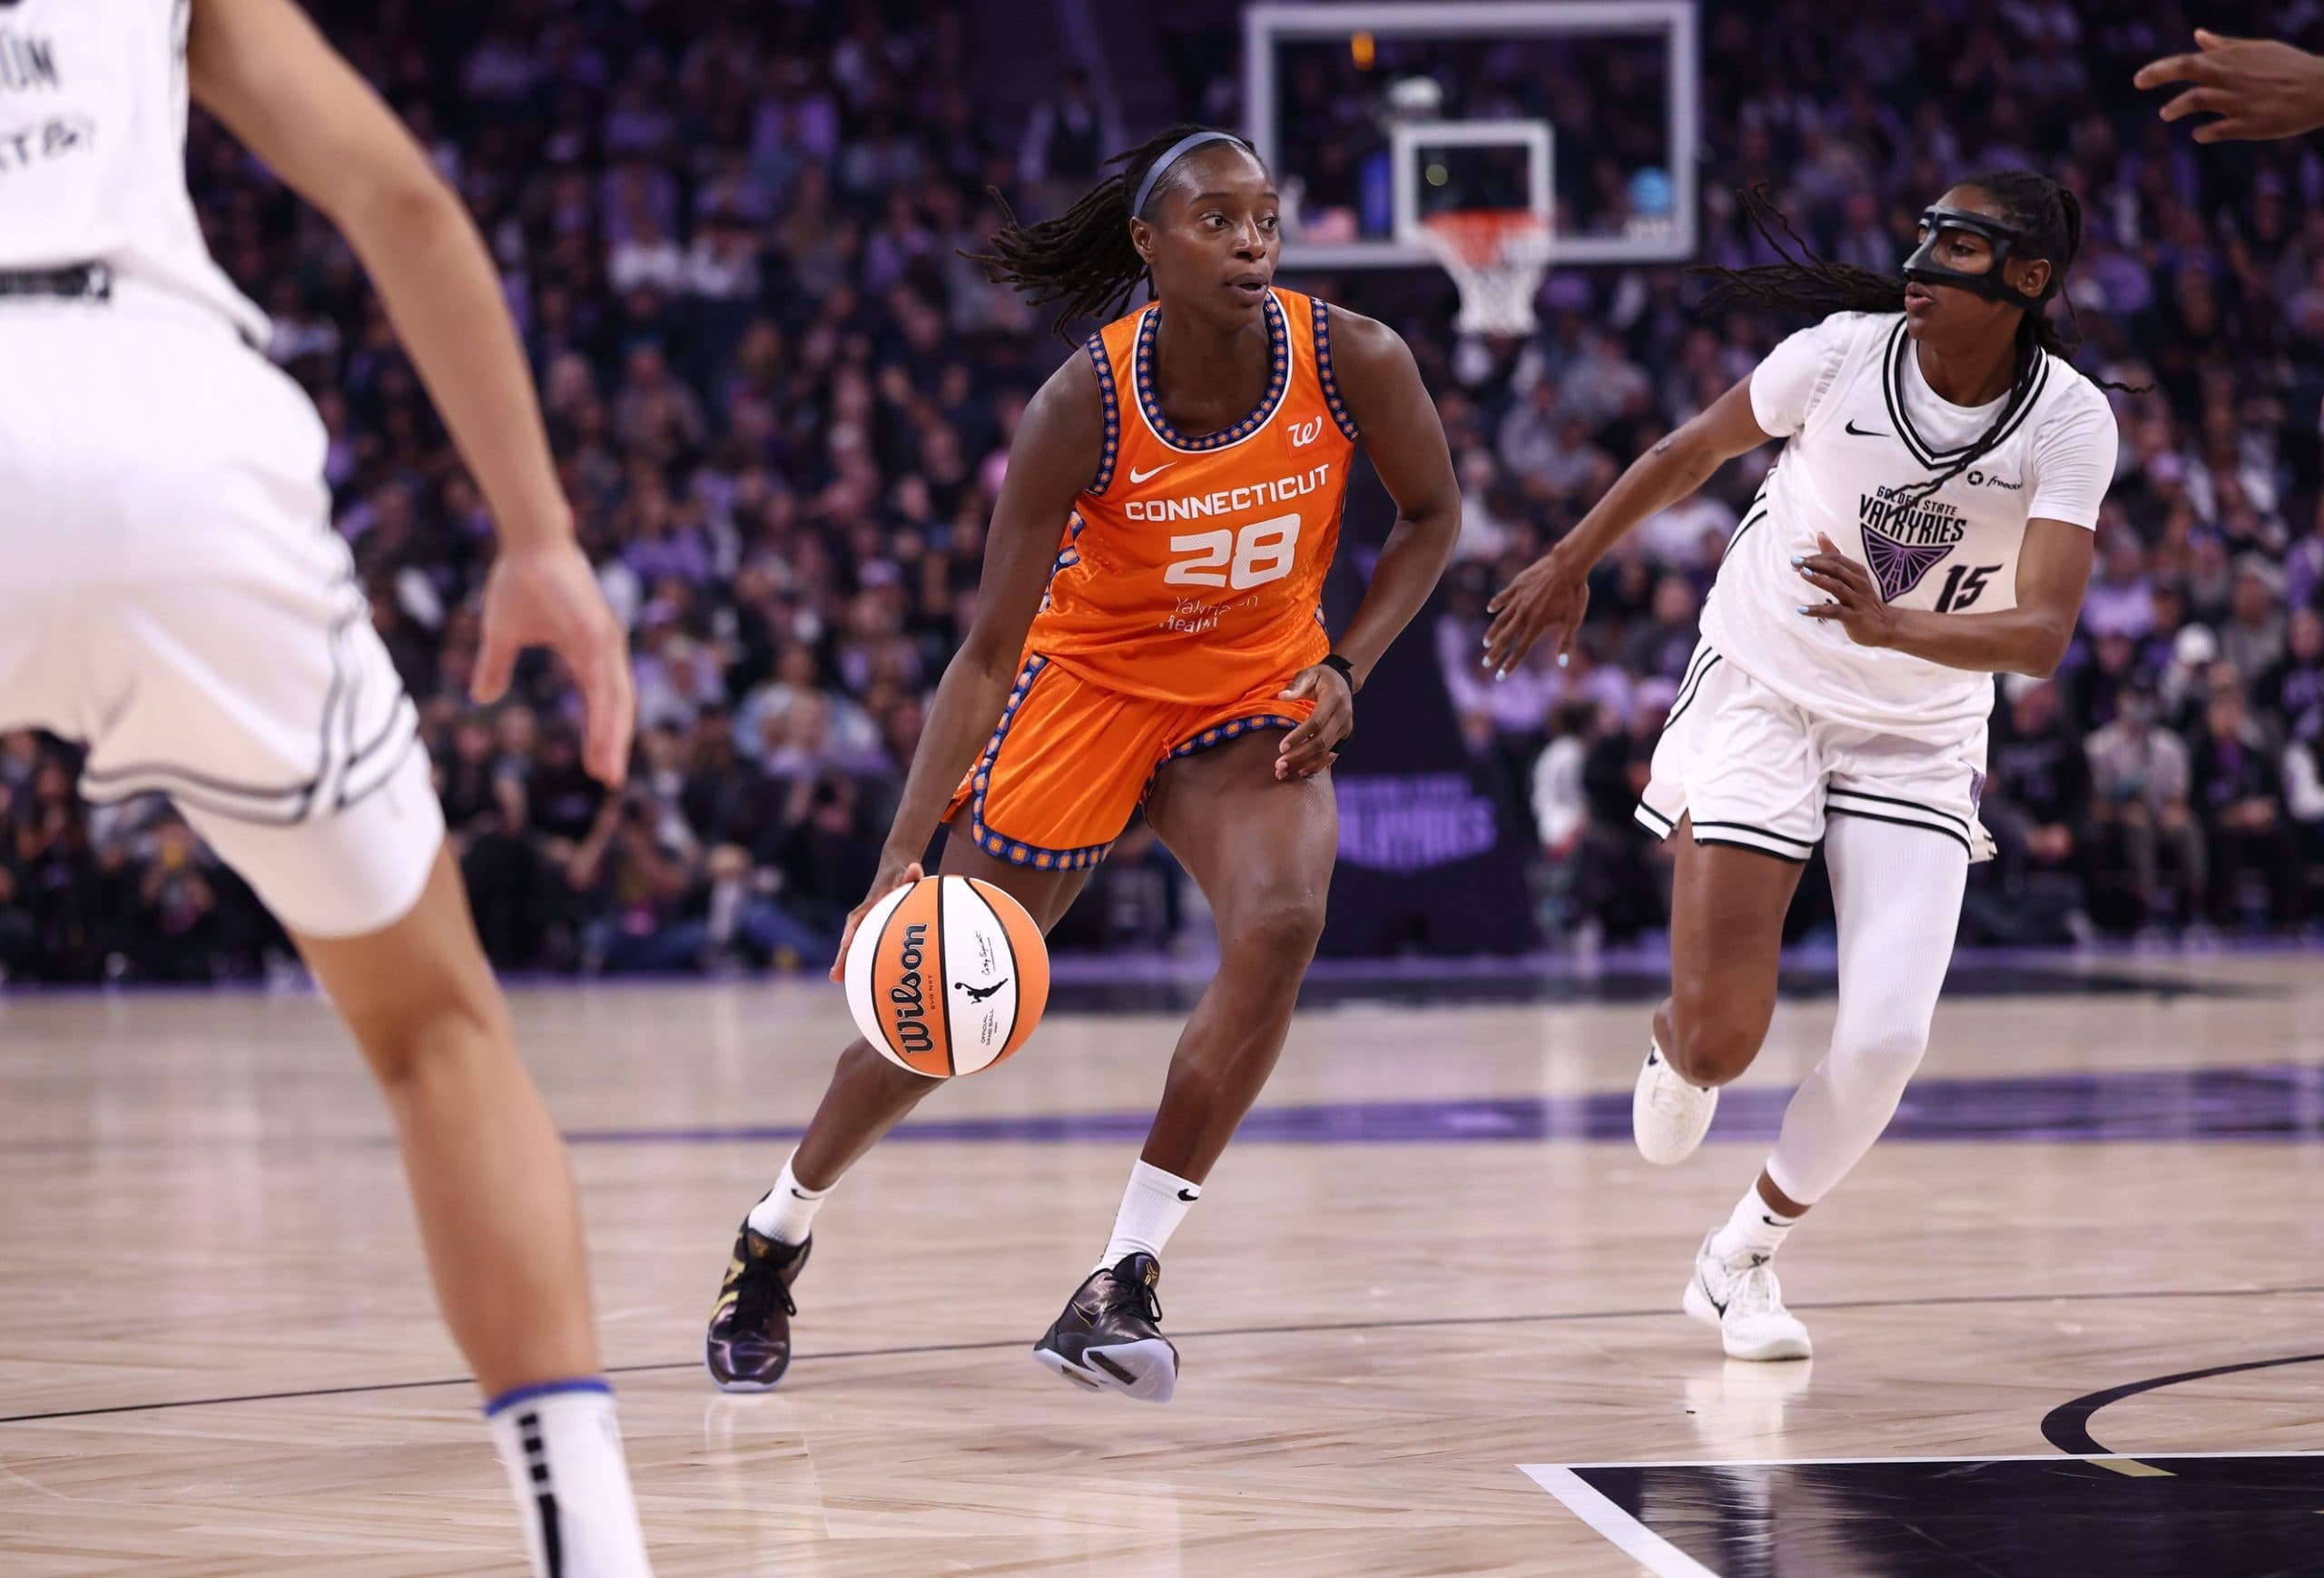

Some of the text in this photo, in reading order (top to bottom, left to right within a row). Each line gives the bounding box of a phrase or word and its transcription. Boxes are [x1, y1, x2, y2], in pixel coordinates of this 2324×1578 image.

[1125, 464, 1330, 521] CONNECTICUT
[1859, 493, 1968, 544] VALKYRIES
[1923, 500, 1958, 517] STATE
[1164, 513, 1301, 590] 28
[1935, 563, 2004, 612] 15
[891, 922, 934, 1054] Wilson
